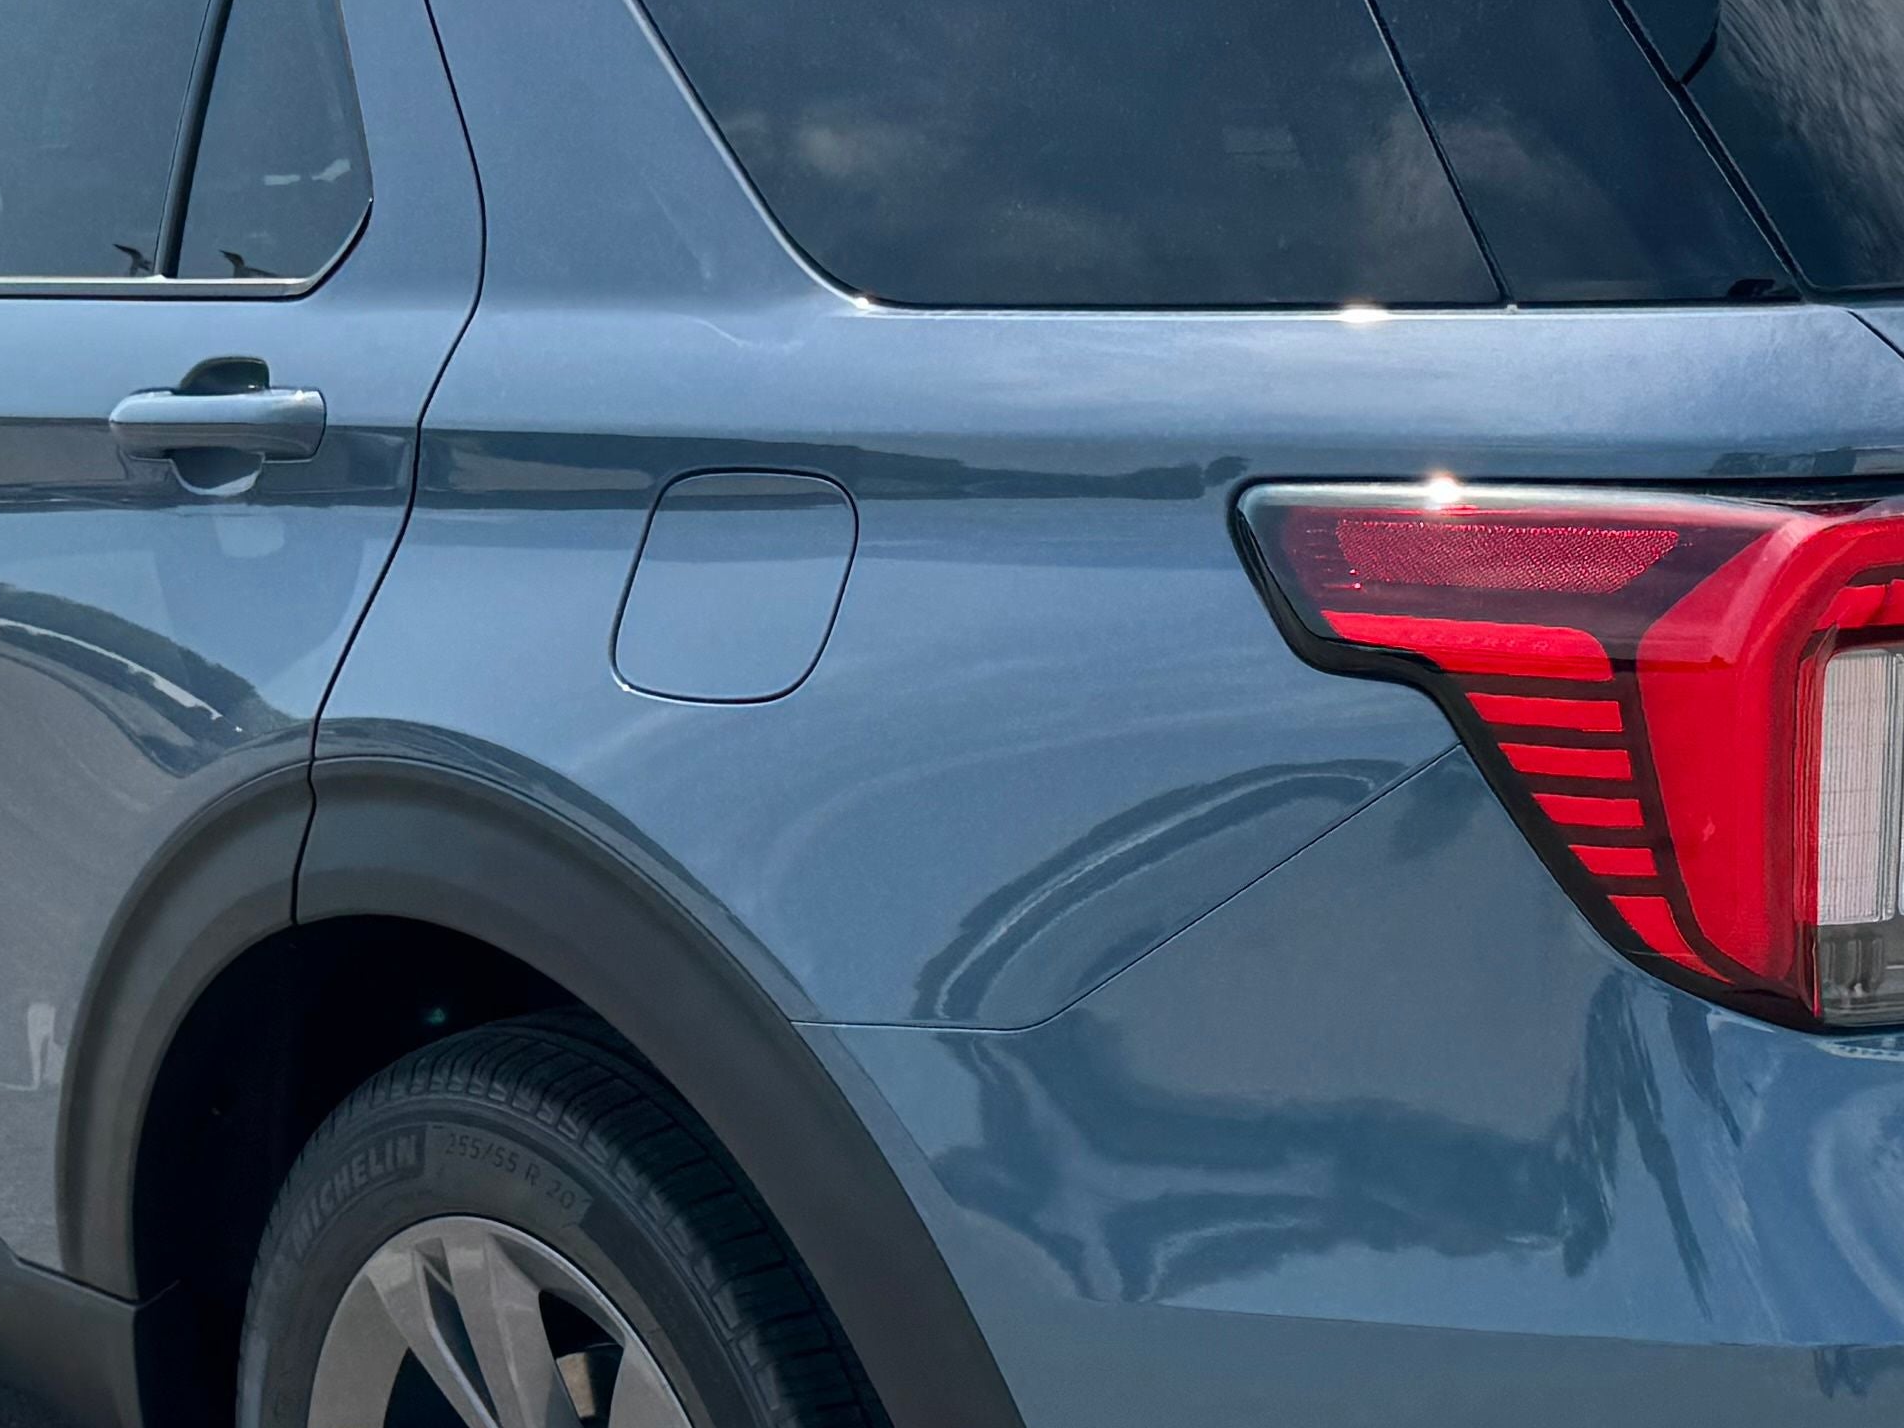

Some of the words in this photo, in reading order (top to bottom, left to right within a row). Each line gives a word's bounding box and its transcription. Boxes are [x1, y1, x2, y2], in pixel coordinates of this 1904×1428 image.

[291, 1134, 417, 1259] MICHELIN
[445, 1132, 520, 1174] 255/55
[524, 1162, 541, 1187] R
[546, 1181, 576, 1211] 20
